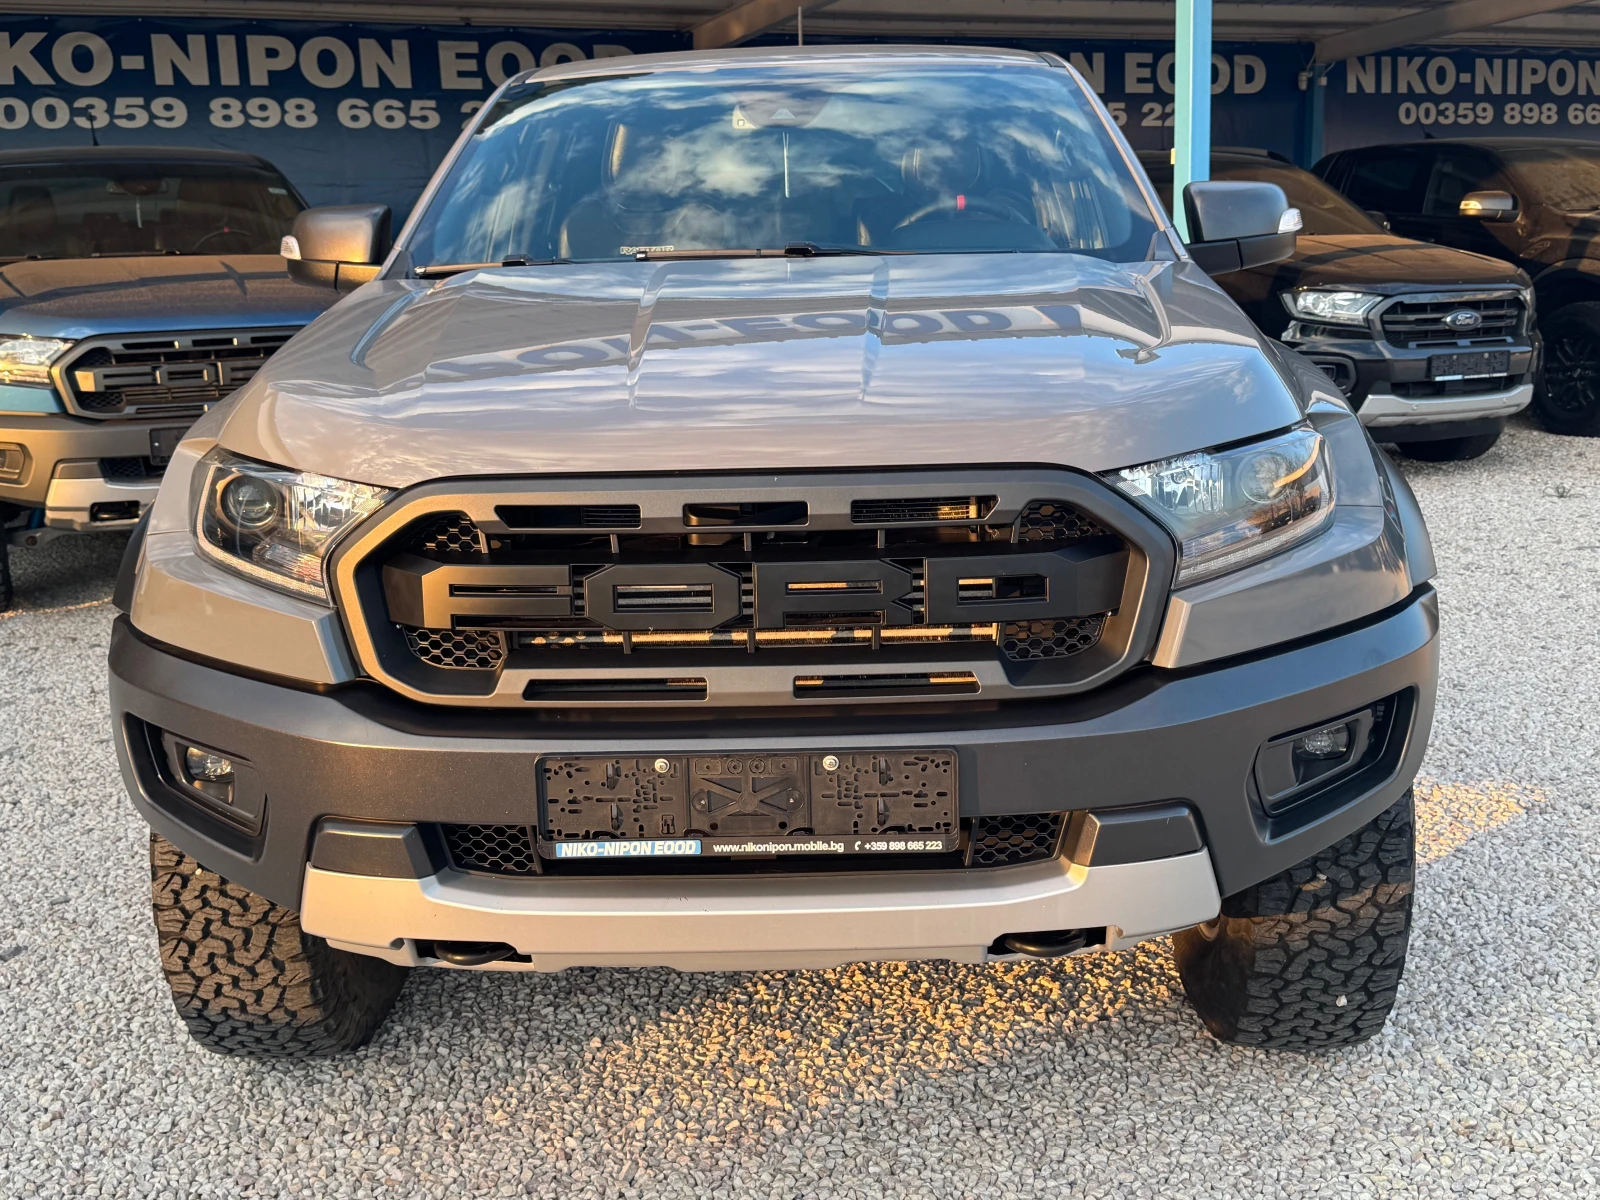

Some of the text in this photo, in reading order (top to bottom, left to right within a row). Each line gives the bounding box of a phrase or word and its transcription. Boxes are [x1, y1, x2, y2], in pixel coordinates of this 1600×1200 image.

[0, 31, 412, 88] KO-NIPON
[1346, 56, 1600, 96] NIKO-NIPON
[0, 97, 188, 130] 00359
[209, 97, 318, 129] 898
[337, 98, 441, 130] 665
[1398, 102, 1494, 125] 00359
[1503, 103, 1558, 125] 898
[410, 556, 1100, 631] FORD
[561, 841, 696, 857] NIKO-NIPON EOOD
[713, 841, 845, 853] www.nikonipon.mobile.bg
[864, 841, 943, 850] +359 898 665 223
